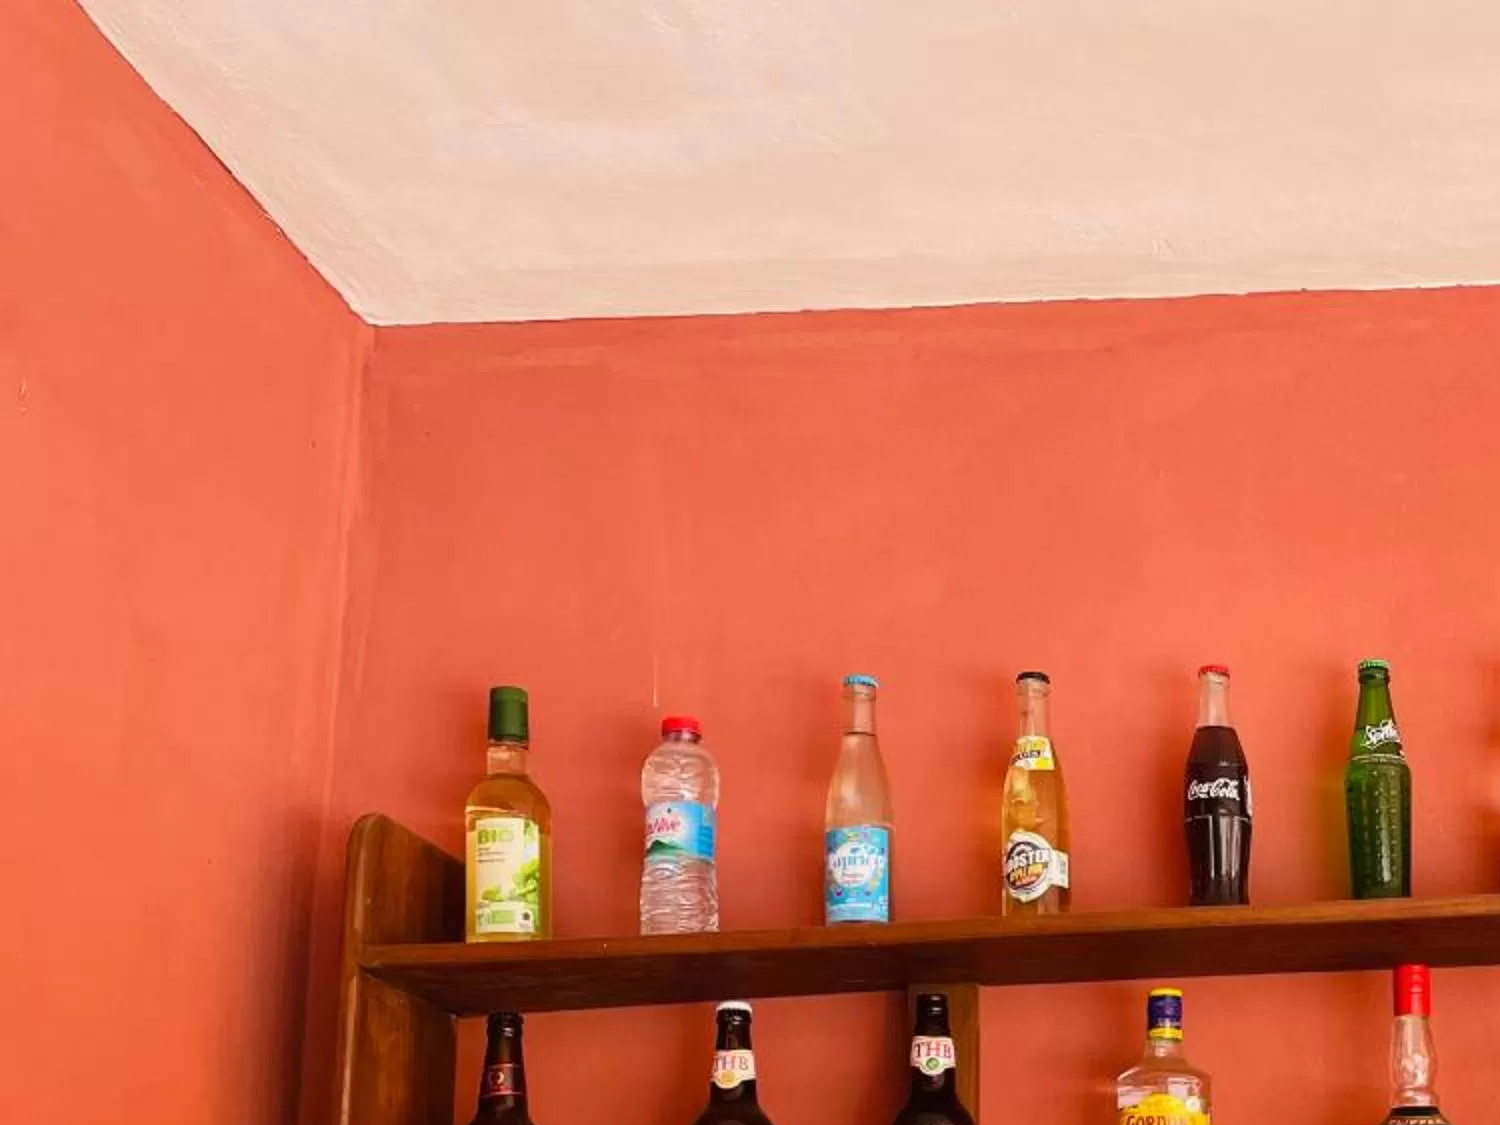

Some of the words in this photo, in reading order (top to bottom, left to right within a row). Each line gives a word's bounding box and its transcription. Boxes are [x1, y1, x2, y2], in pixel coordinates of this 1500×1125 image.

[1187, 777, 1241, 801] Coca-Cola
[914, 1042, 952, 1059] THB
[714, 1055, 749, 1072] THB
